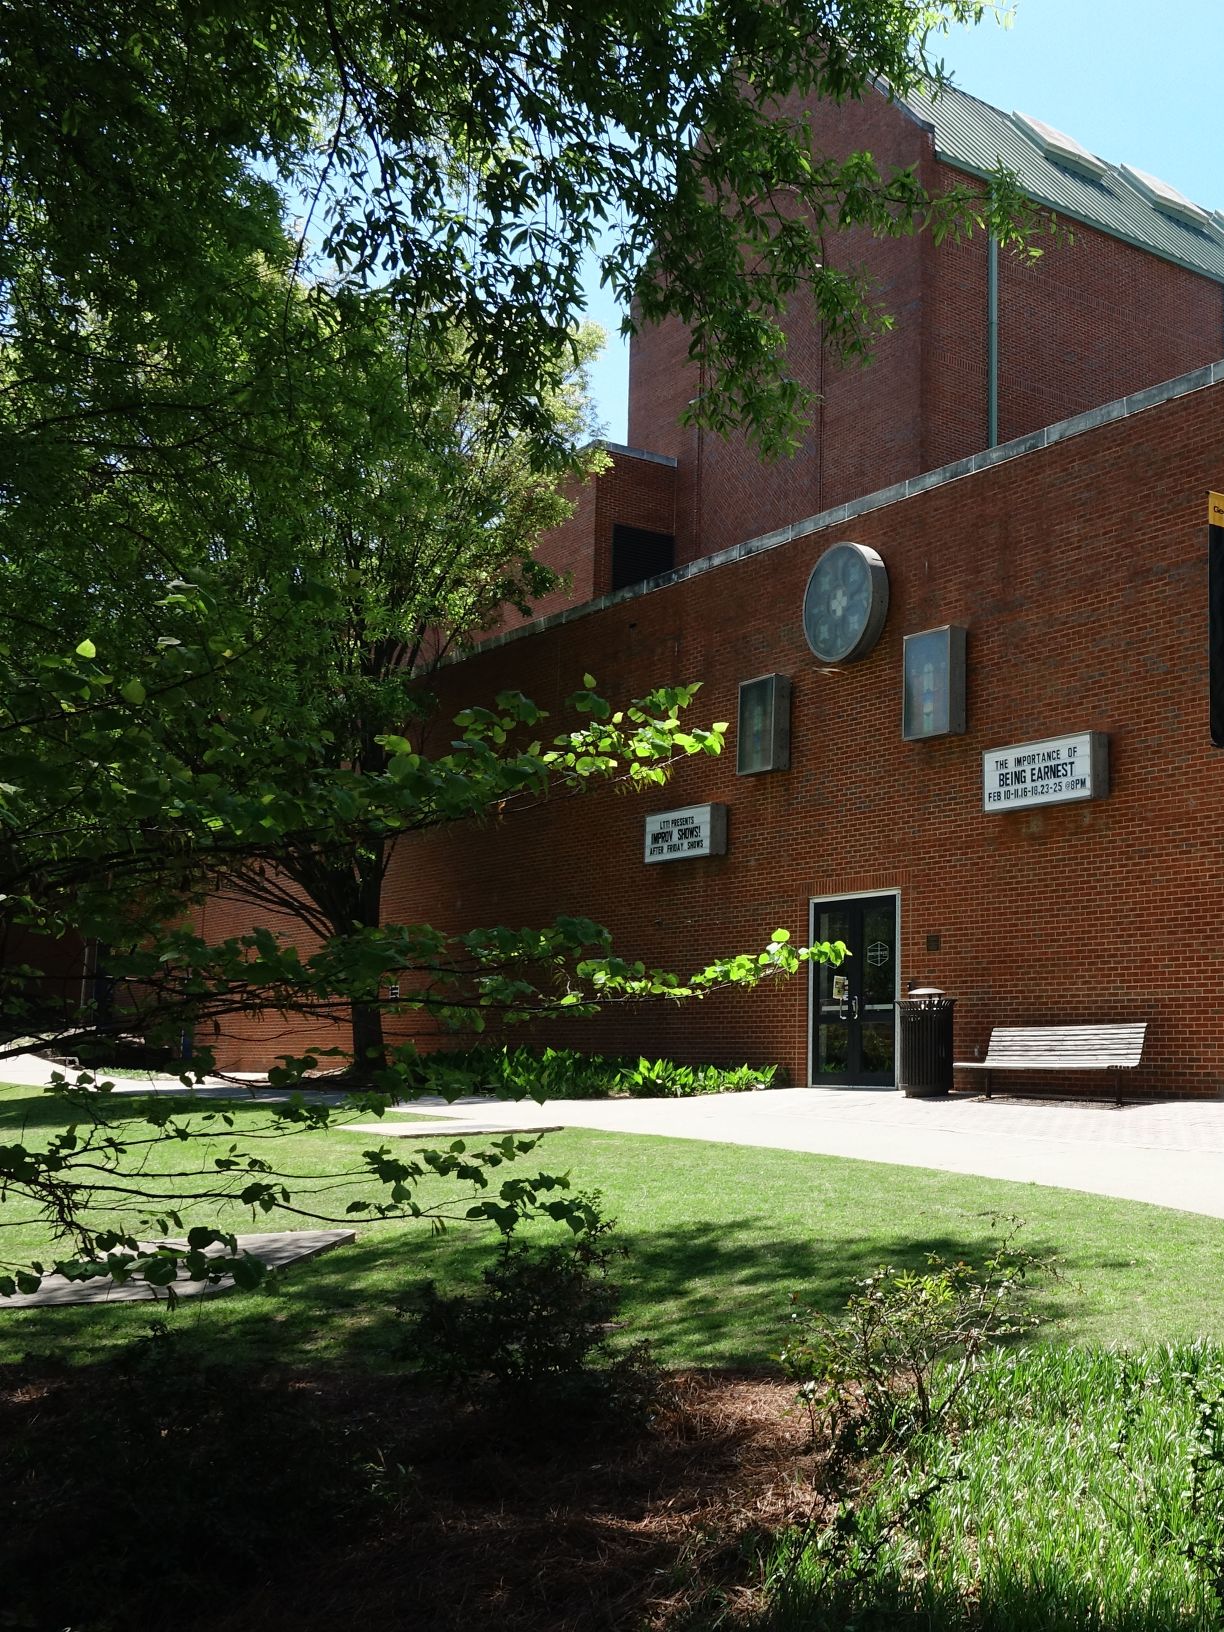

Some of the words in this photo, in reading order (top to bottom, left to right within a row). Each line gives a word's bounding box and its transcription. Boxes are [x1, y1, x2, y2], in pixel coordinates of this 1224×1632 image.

[995, 759, 1008, 770] THE
[1014, 749, 1061, 767] IMPORTANCE
[1067, 747, 1078, 757] OF
[999, 768, 1026, 787] BEING
[1031, 761, 1075, 782] EARNEST
[988, 792, 1001, 803] FEB
[1065, 778, 1086, 790] @8PM
[671, 816, 694, 828] PRESENTS
[651, 830, 673, 845] IMPROV
[678, 826, 700, 840] SHOWS!
[650, 846, 663, 856] AFTER
[688, 840, 703, 850] SHOWS
